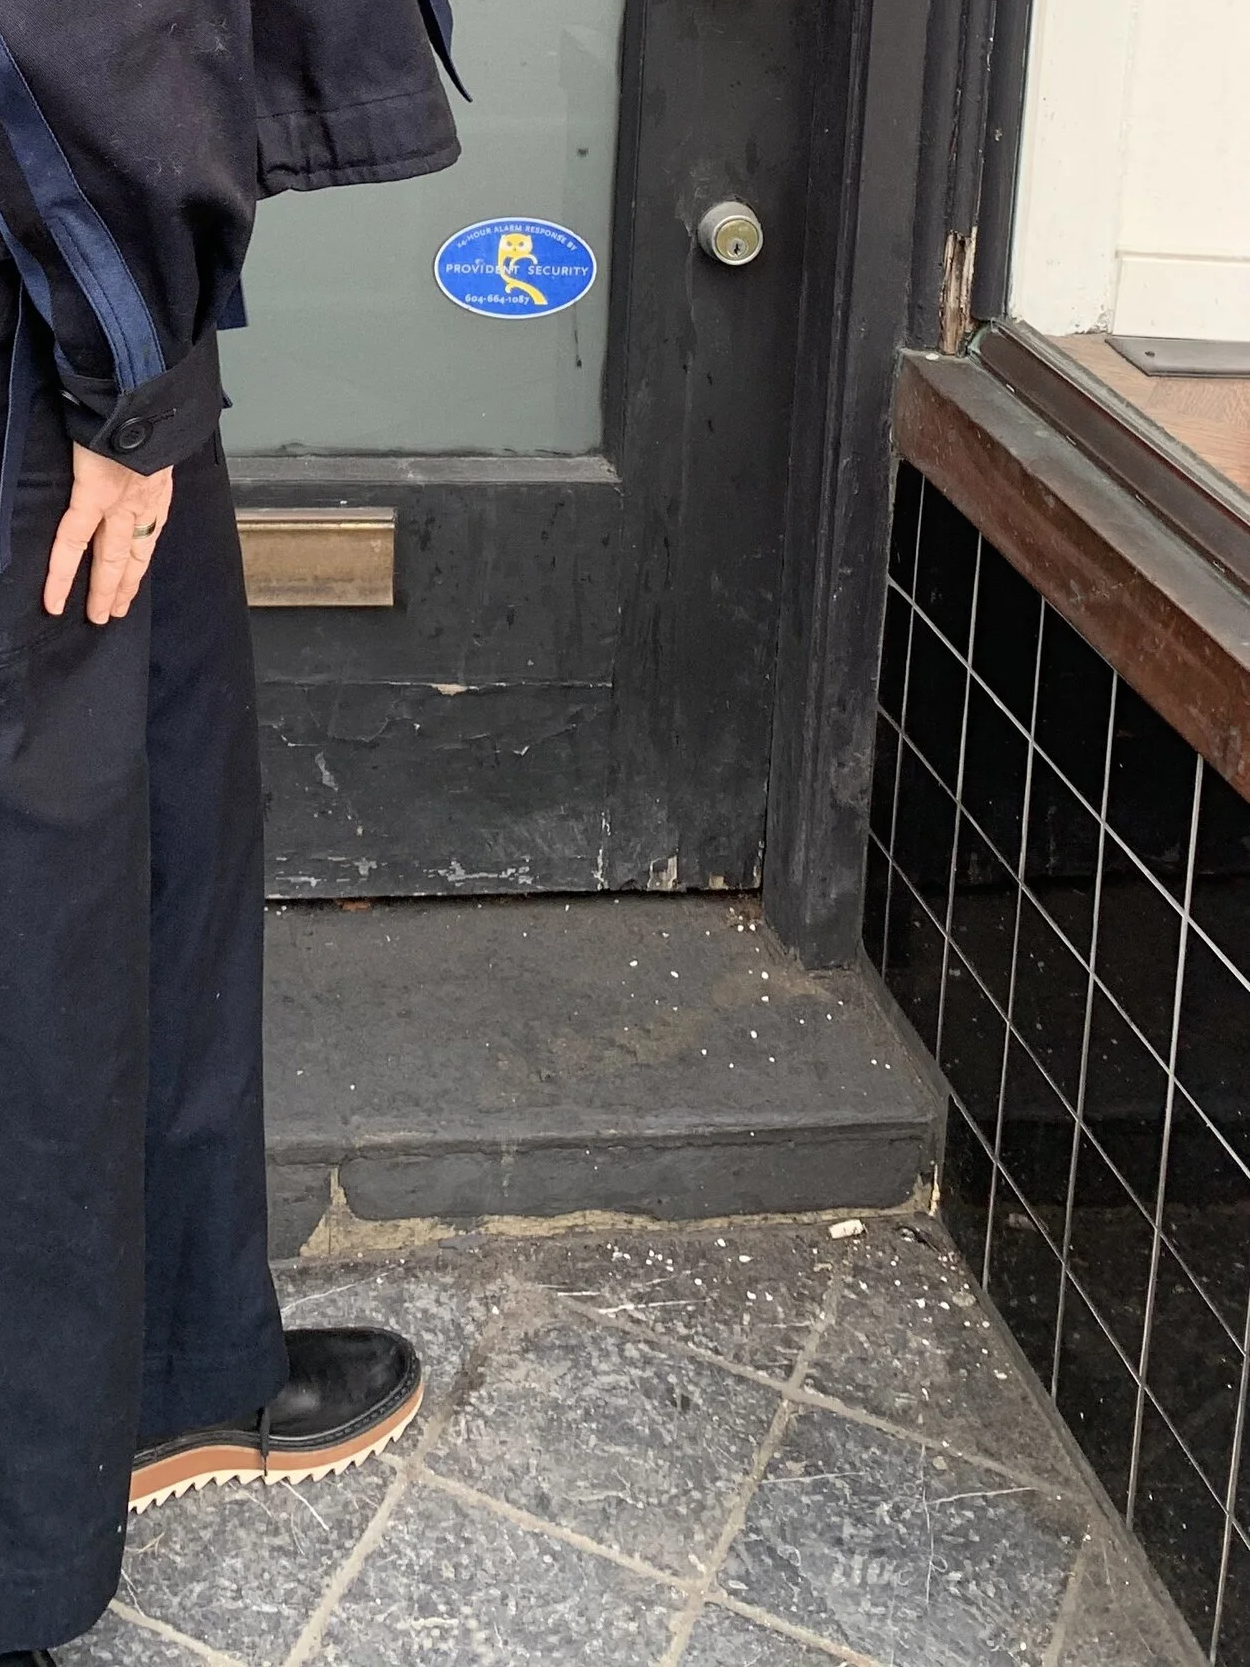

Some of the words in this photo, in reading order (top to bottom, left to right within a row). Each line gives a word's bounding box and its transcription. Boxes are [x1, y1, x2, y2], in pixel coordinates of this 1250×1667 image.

[493, 224, 522, 233] ALARM
[524, 225, 568, 245] RESPONSE
[566, 241, 578, 251] BY
[445, 263, 520, 276] PROVIDENT
[527, 265, 589, 277] SECURITY
